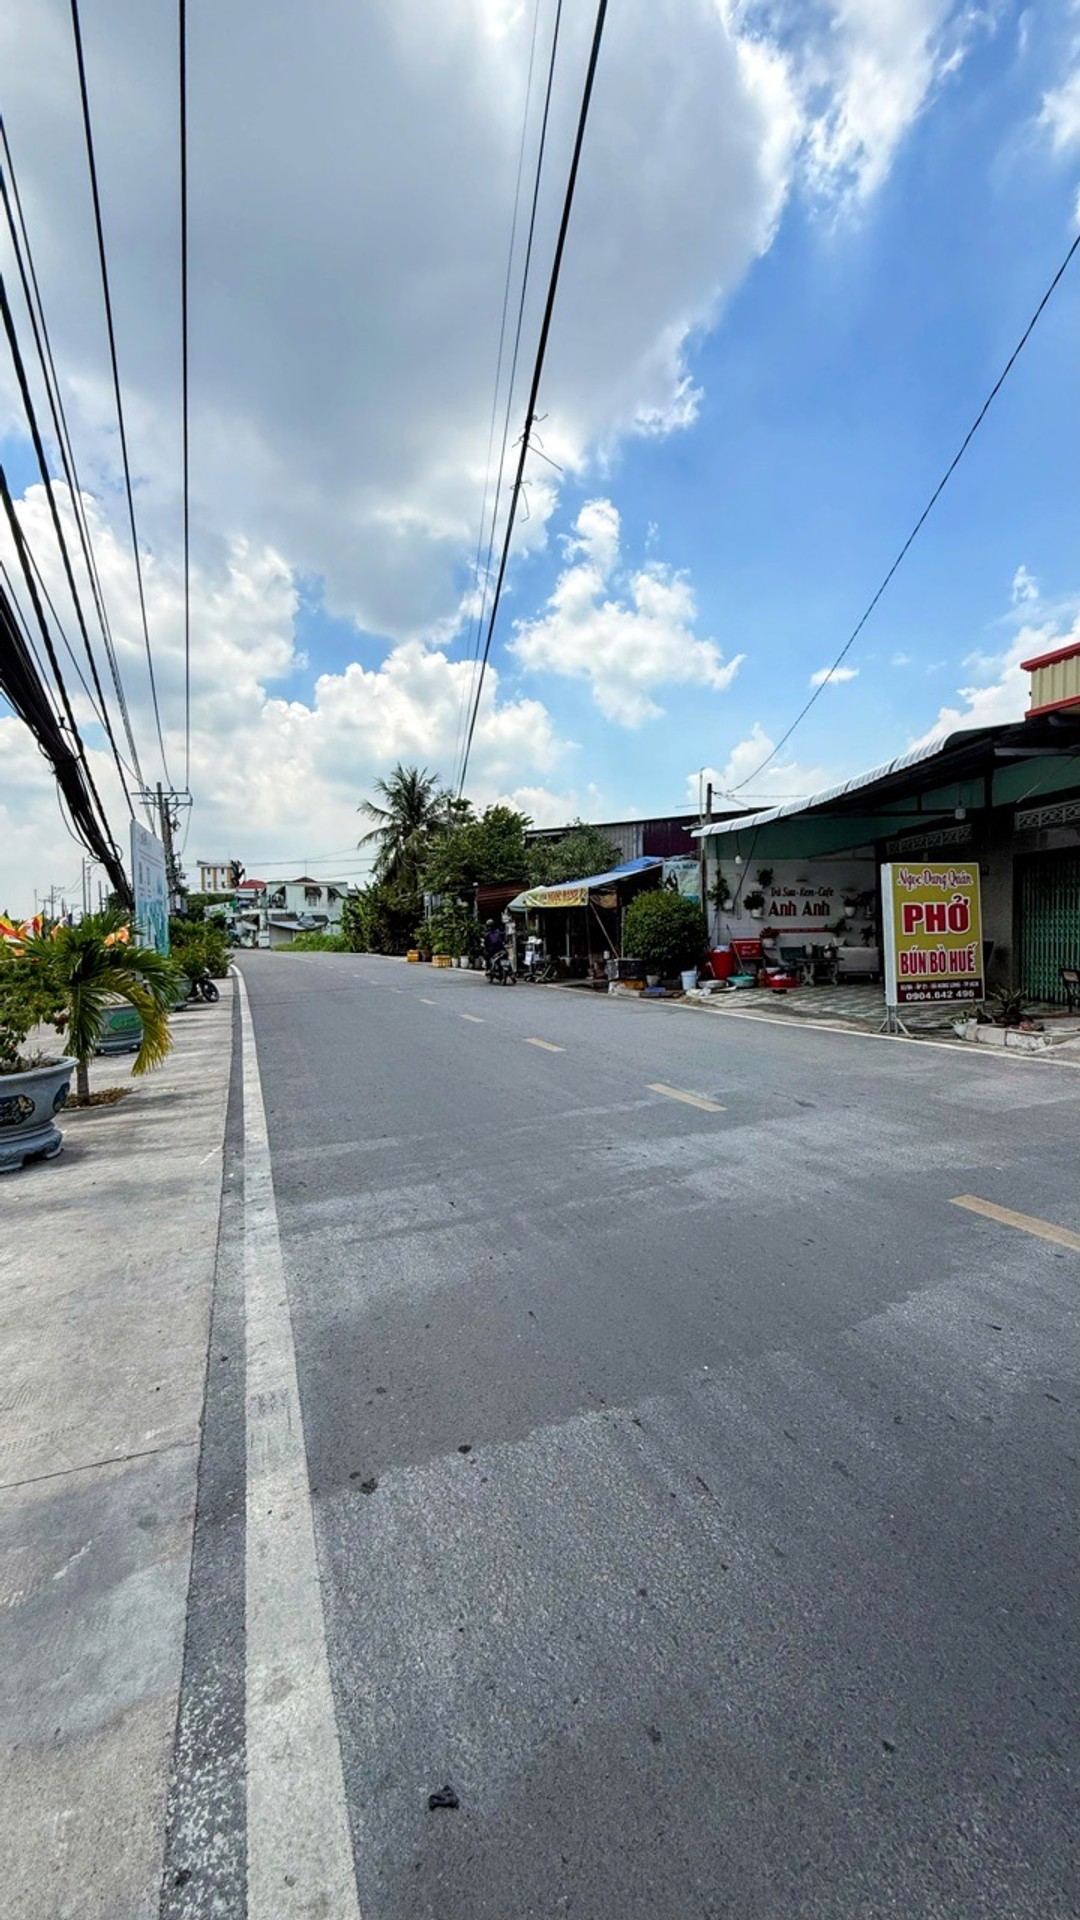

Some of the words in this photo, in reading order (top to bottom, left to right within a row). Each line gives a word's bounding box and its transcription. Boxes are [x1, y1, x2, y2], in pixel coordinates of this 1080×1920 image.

[947, 868, 973, 889] Quán
[769, 900, 797, 917] Anh
[802, 900, 830, 917] Anh
[902, 893, 970, 935] PHỞ
[899, 945, 927, 976] BÚN
[928, 944, 947, 974] BÒ
[948, 941, 978, 974] HUẾ
